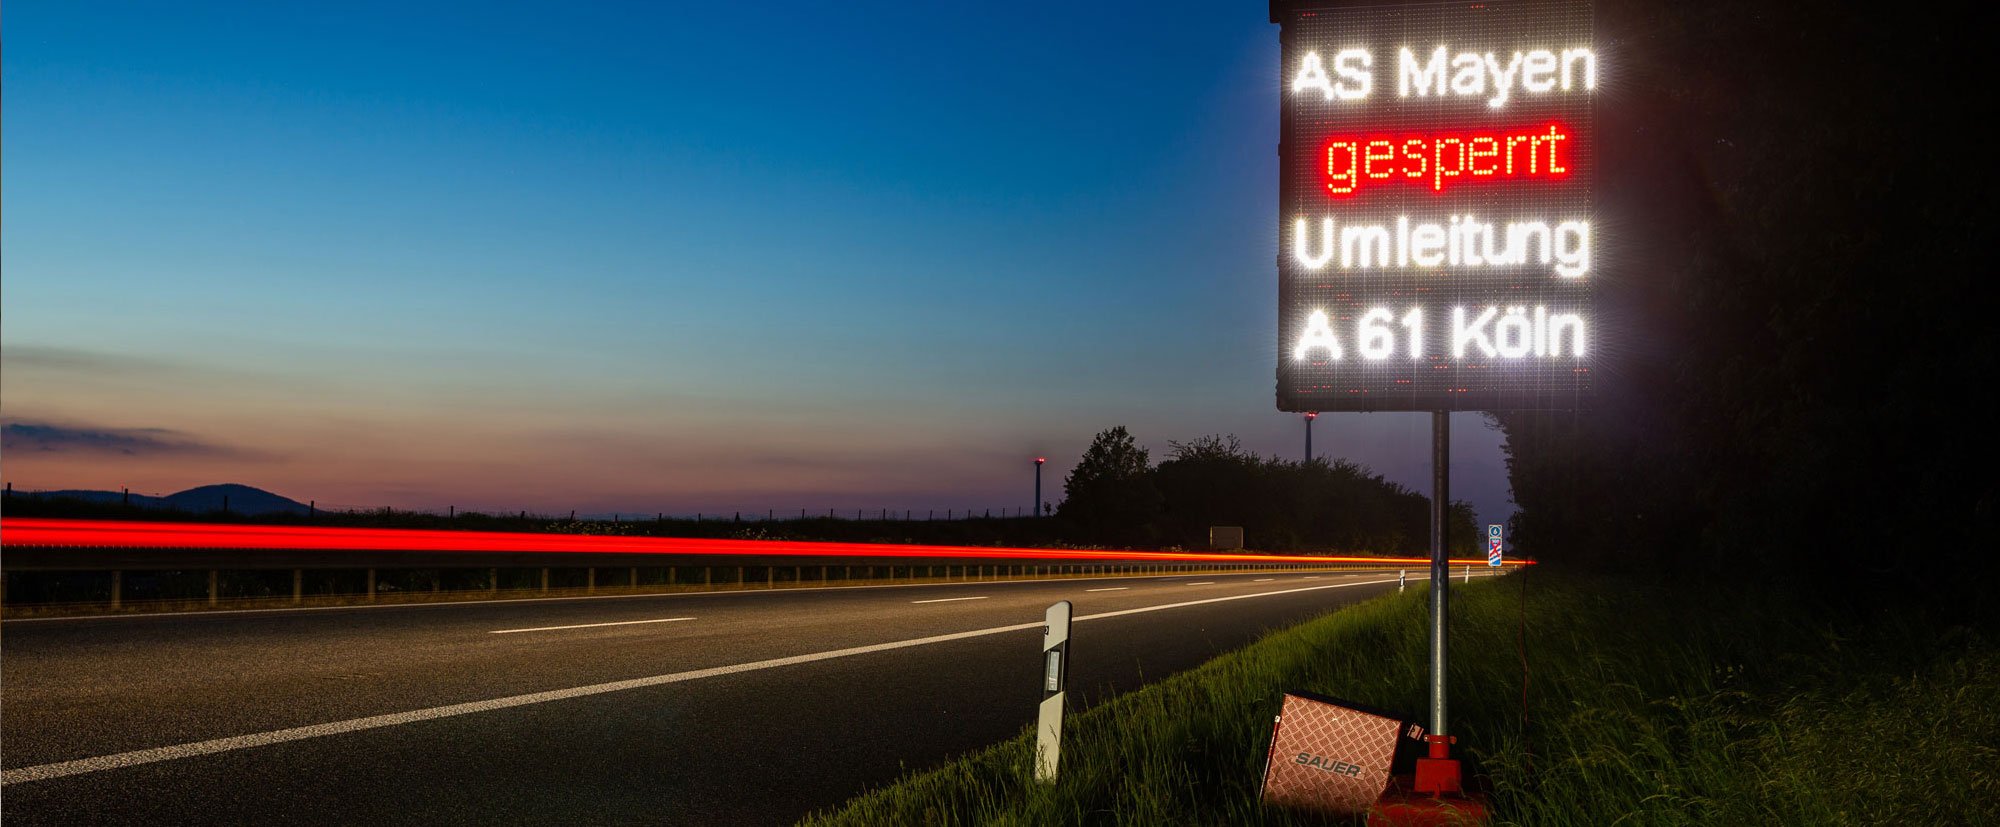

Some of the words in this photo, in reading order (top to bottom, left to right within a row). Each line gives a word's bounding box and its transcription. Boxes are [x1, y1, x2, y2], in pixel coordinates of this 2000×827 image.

[1294, 48, 1372, 99] AS
[1399, 47, 1597, 108] Mayen
[1327, 125, 1567, 193] gesperrt
[1296, 215, 1590, 277] Umleitung
[1294, 309, 1342, 360] A
[1358, 307, 1422, 359] 61
[1453, 306, 1585, 358] Köln
[1295, 752, 1361, 777] SAUER
